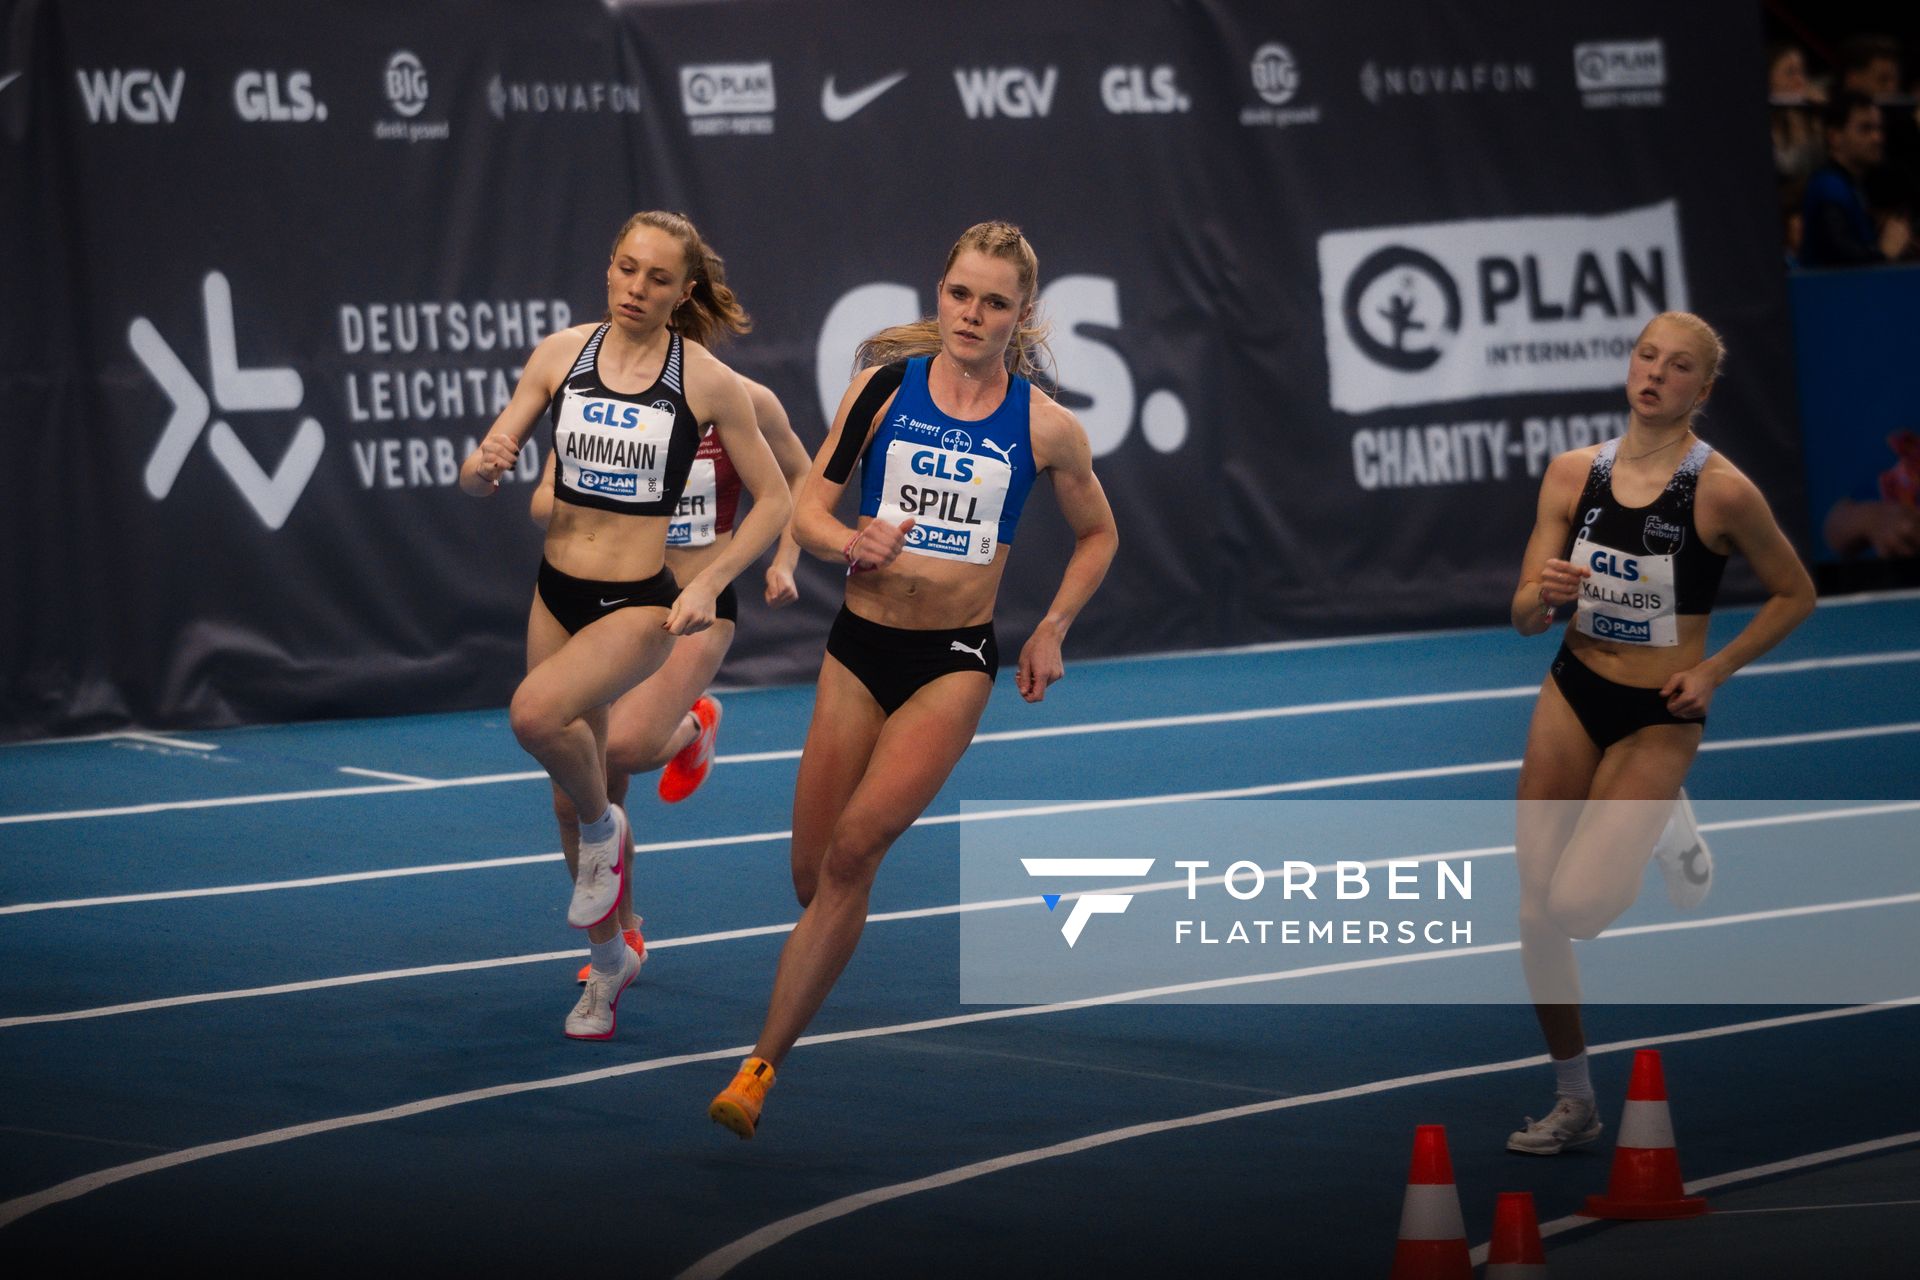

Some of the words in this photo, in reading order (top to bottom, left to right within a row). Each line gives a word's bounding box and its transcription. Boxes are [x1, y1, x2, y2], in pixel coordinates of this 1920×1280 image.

[386, 69, 428, 101] BIG
[1100, 65, 1191, 114] GLS.
[1250, 61, 1298, 91] BIG
[1384, 64, 1534, 95] NOVAFON
[76, 68, 185, 123] WGV
[234, 70, 328, 122] GLS.
[510, 81, 641, 113] NOVAFON
[954, 65, 1059, 119] WGV
[1478, 246, 1668, 326] PLAN
[909, 419, 941, 433] bunert
[566, 431, 656, 470] AMMANN
[944, 437, 970, 447] BAYER
[354, 436, 541, 489] VERBD
[600, 475, 634, 488] PLAN
[648, 477, 657, 493] 368
[674, 495, 706, 517] ER
[900, 484, 981, 525] SPILL
[929, 530, 968, 547] PLAN
[980, 536, 991, 555] 303
[1643, 527, 1680, 542] Freiburg
[1583, 581, 1662, 610] KALLABIS
[1613, 622, 1648, 635] PLAN
